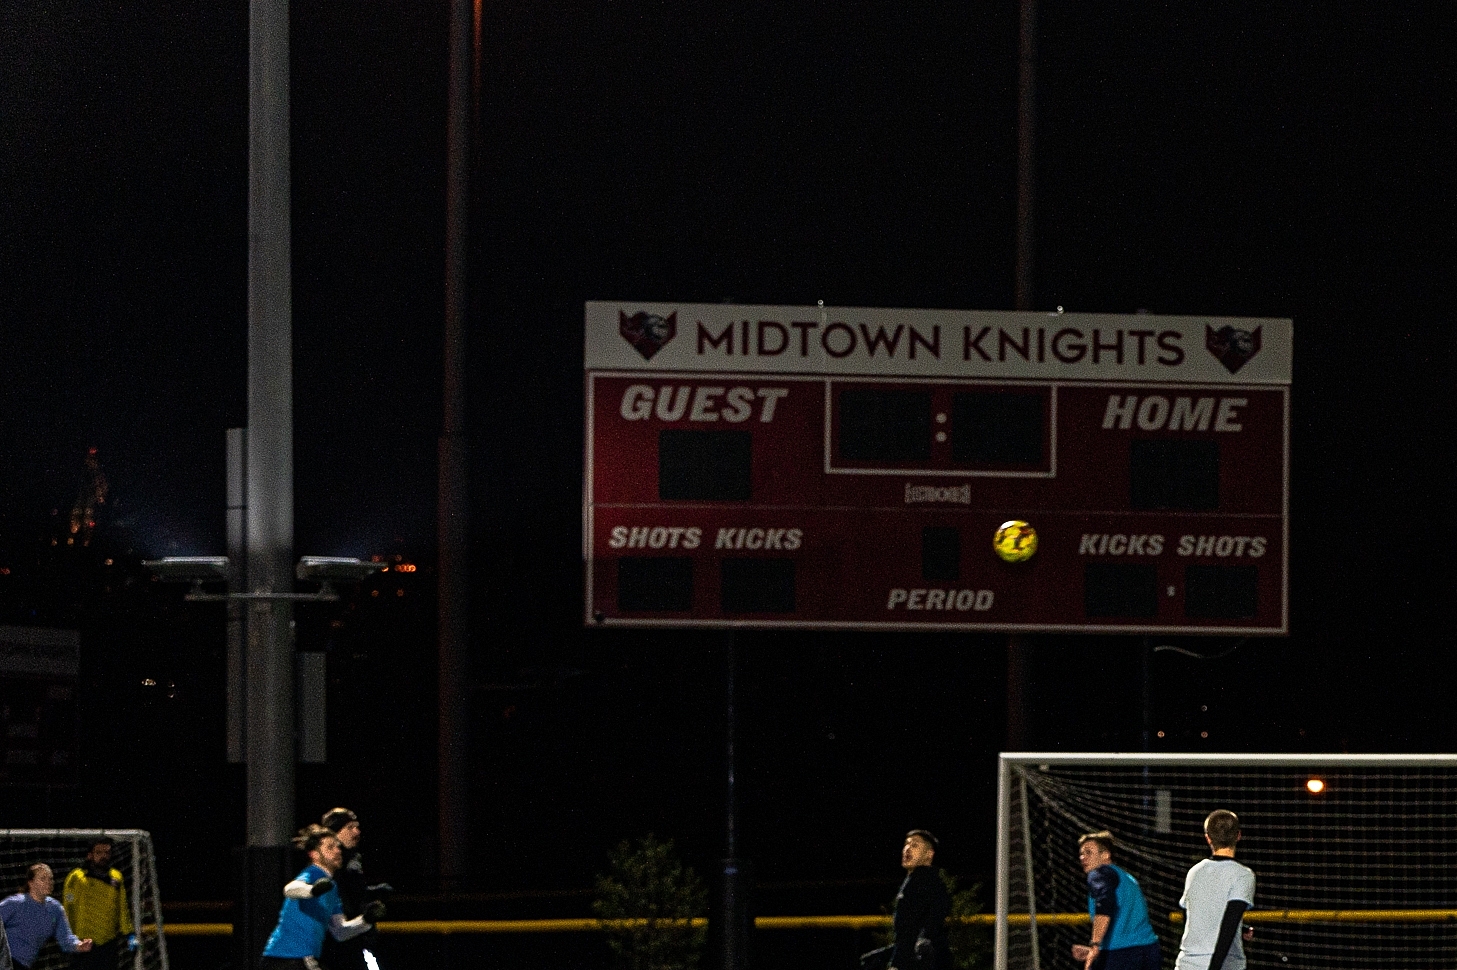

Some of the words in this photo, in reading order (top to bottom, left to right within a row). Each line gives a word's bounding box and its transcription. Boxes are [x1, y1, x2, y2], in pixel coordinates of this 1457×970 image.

[696, 320, 941, 360] MIDTOWN
[962, 325, 1186, 366] KNIGHTS
[619, 384, 789, 424] GUEST
[1101, 394, 1249, 432] HOME
[608, 525, 702, 549] SHOTS
[715, 527, 803, 550] KICKS
[1078, 533, 1165, 556] KICKS
[1176, 534, 1268, 558] SHOTS
[887, 588, 995, 612] PERIOD
